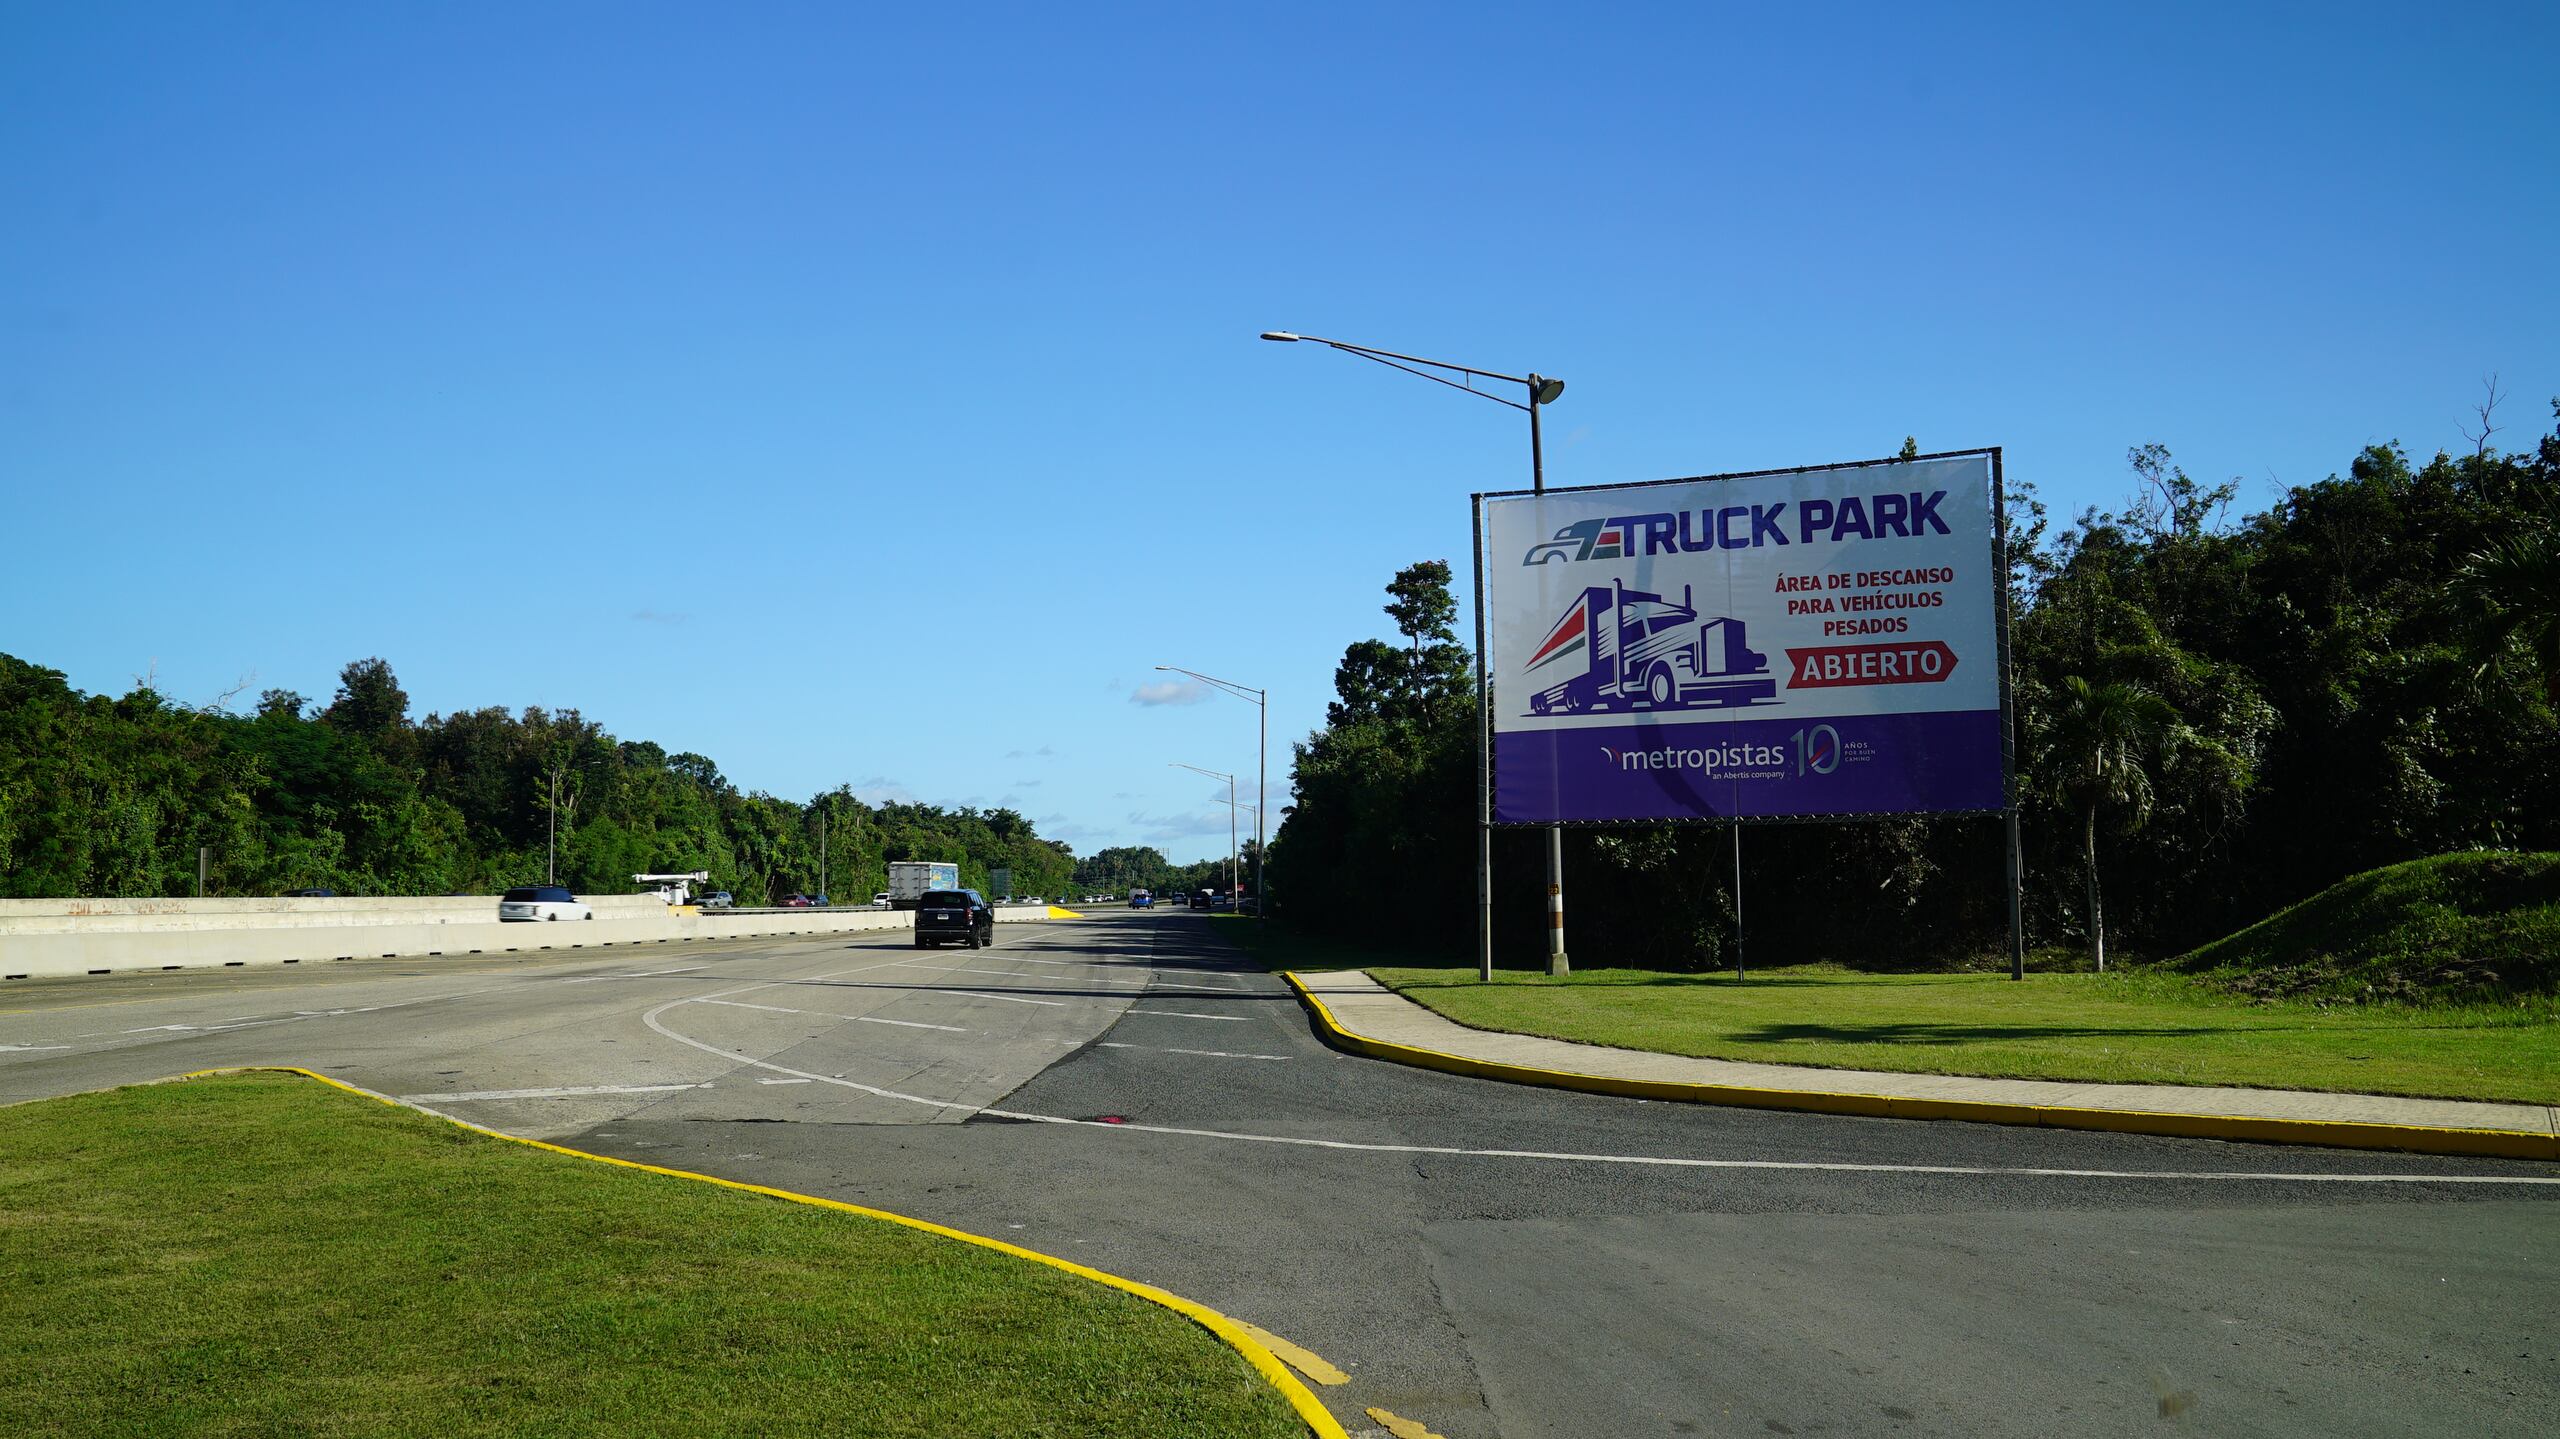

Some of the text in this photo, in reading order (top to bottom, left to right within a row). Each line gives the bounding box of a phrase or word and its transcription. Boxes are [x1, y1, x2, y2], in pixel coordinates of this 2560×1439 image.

[1602, 490, 1952, 558] TRUCK PARK
[1775, 567, 1954, 593] ÁREA DE DESCANSO
[1788, 589, 1943, 615] PARA VEHÍCULOS
[1824, 617, 1908, 636] PESADOS
[1802, 649, 1942, 681] ABIERTO
[1789, 724, 1841, 777] 10
[1844, 741, 1868, 749] AÑOS
[1622, 741, 1785, 776] metropistas
[1723, 771, 1750, 779] Abertis
[1751, 771, 1785, 780] company
